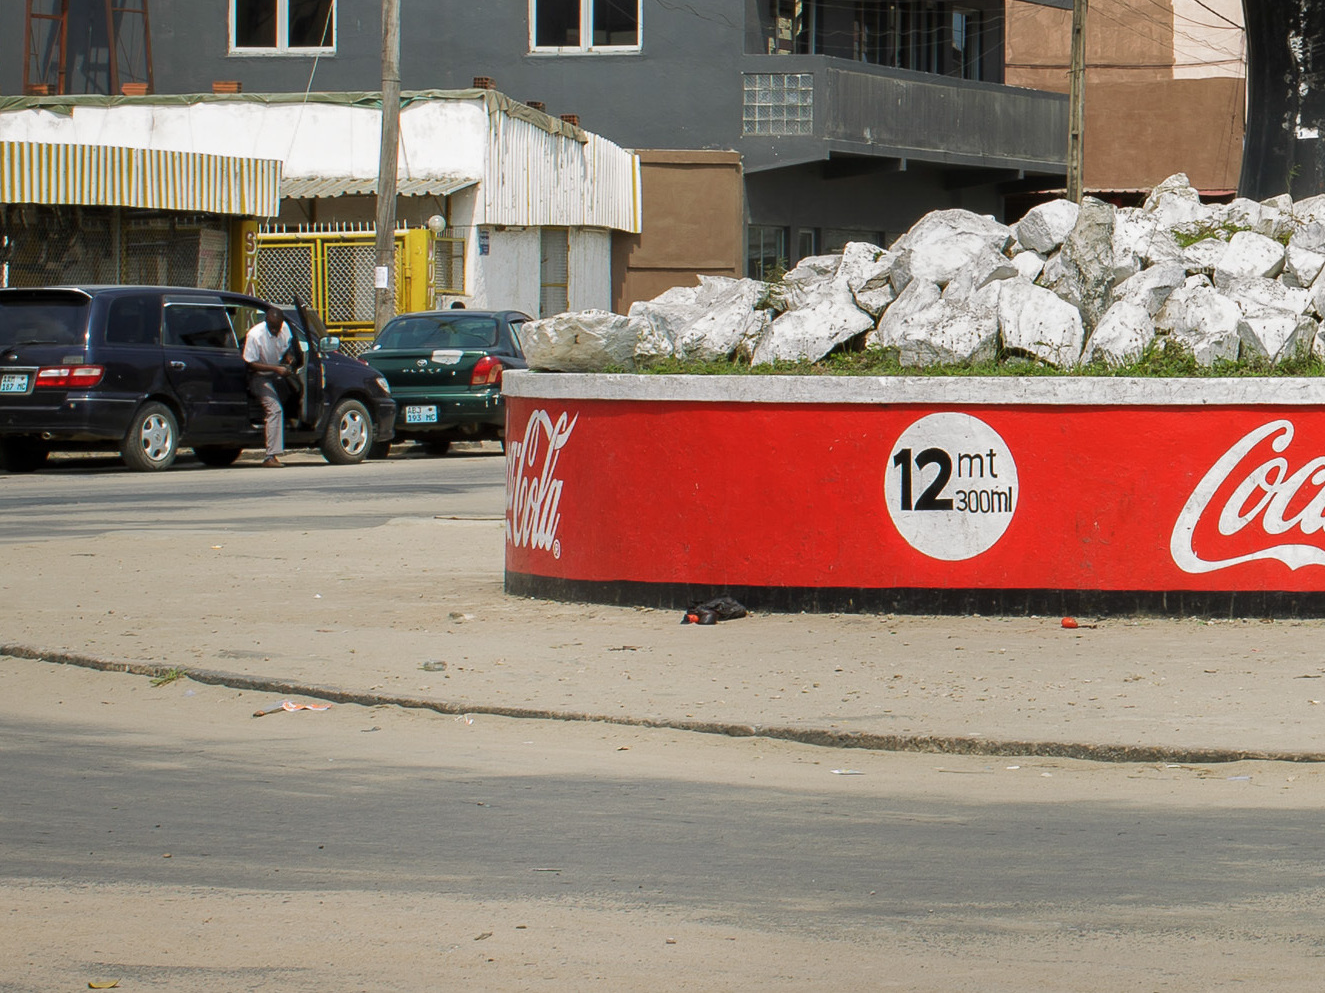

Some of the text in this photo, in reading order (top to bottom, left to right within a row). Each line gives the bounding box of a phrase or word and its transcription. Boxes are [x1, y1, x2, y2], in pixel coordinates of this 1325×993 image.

[893, 447, 998, 511] 12 mt
[955, 486, 1013, 513] 300ml
